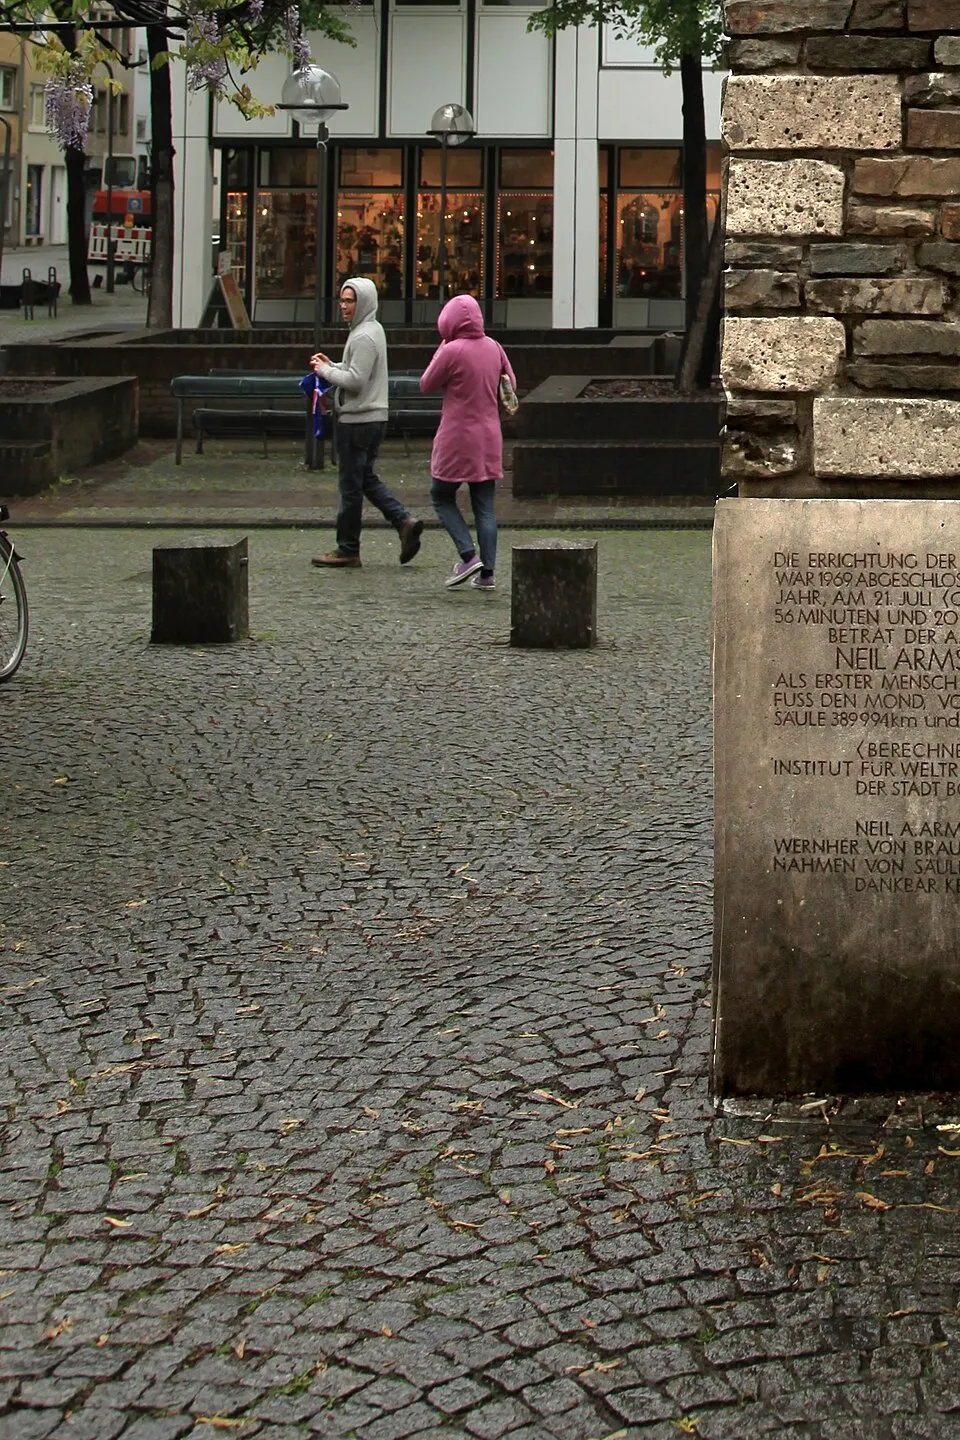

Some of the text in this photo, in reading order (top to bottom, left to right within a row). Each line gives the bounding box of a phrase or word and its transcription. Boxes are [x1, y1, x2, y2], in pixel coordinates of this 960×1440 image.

[774, 552, 800, 568] DIE
[808, 553, 918, 569] ERRICHTUNG
[926, 553, 957, 569] DER
[775, 571, 815, 587] WAR
[818, 571, 853, 587] 1969
[775, 589, 827, 607] JAHR,
[832, 590, 866, 606] AM
[873, 590, 893, 606] 21.
[899, 591, 932, 606] JULI
[774, 609, 794, 624] 56
[798, 609, 879, 625] MINUTEN
[887, 610, 927, 625] UND
[934, 610, 959, 626] 20
[828, 628, 895, 644] BETRAT
[905, 629, 937, 644] DER
[836, 646, 887, 670] NEIL
[775, 673, 807, 689] ALS
[815, 674, 873, 690] ERSTER
[881, 674, 957, 690] MENSCH
[774, 692, 814, 708] FUSS
[820, 692, 857, 709] DEN
[864, 693, 926, 710] MOND,
[774, 710, 826, 726] SÄULE
[924, 712, 960, 728] und
[773, 759, 853, 776] INSTITUT
[861, 761, 895, 777] FÜR
[856, 780, 887, 796] DER
[891, 781, 941, 796] STADT
[855, 820, 894, 836] NEIL
[774, 838, 860, 855] WERNHER
[866, 839, 906, 855] VON
[773, 856, 856, 873] NAHMEN
[864, 858, 904, 874] VON
[855, 877, 939, 894] DANKBAR
